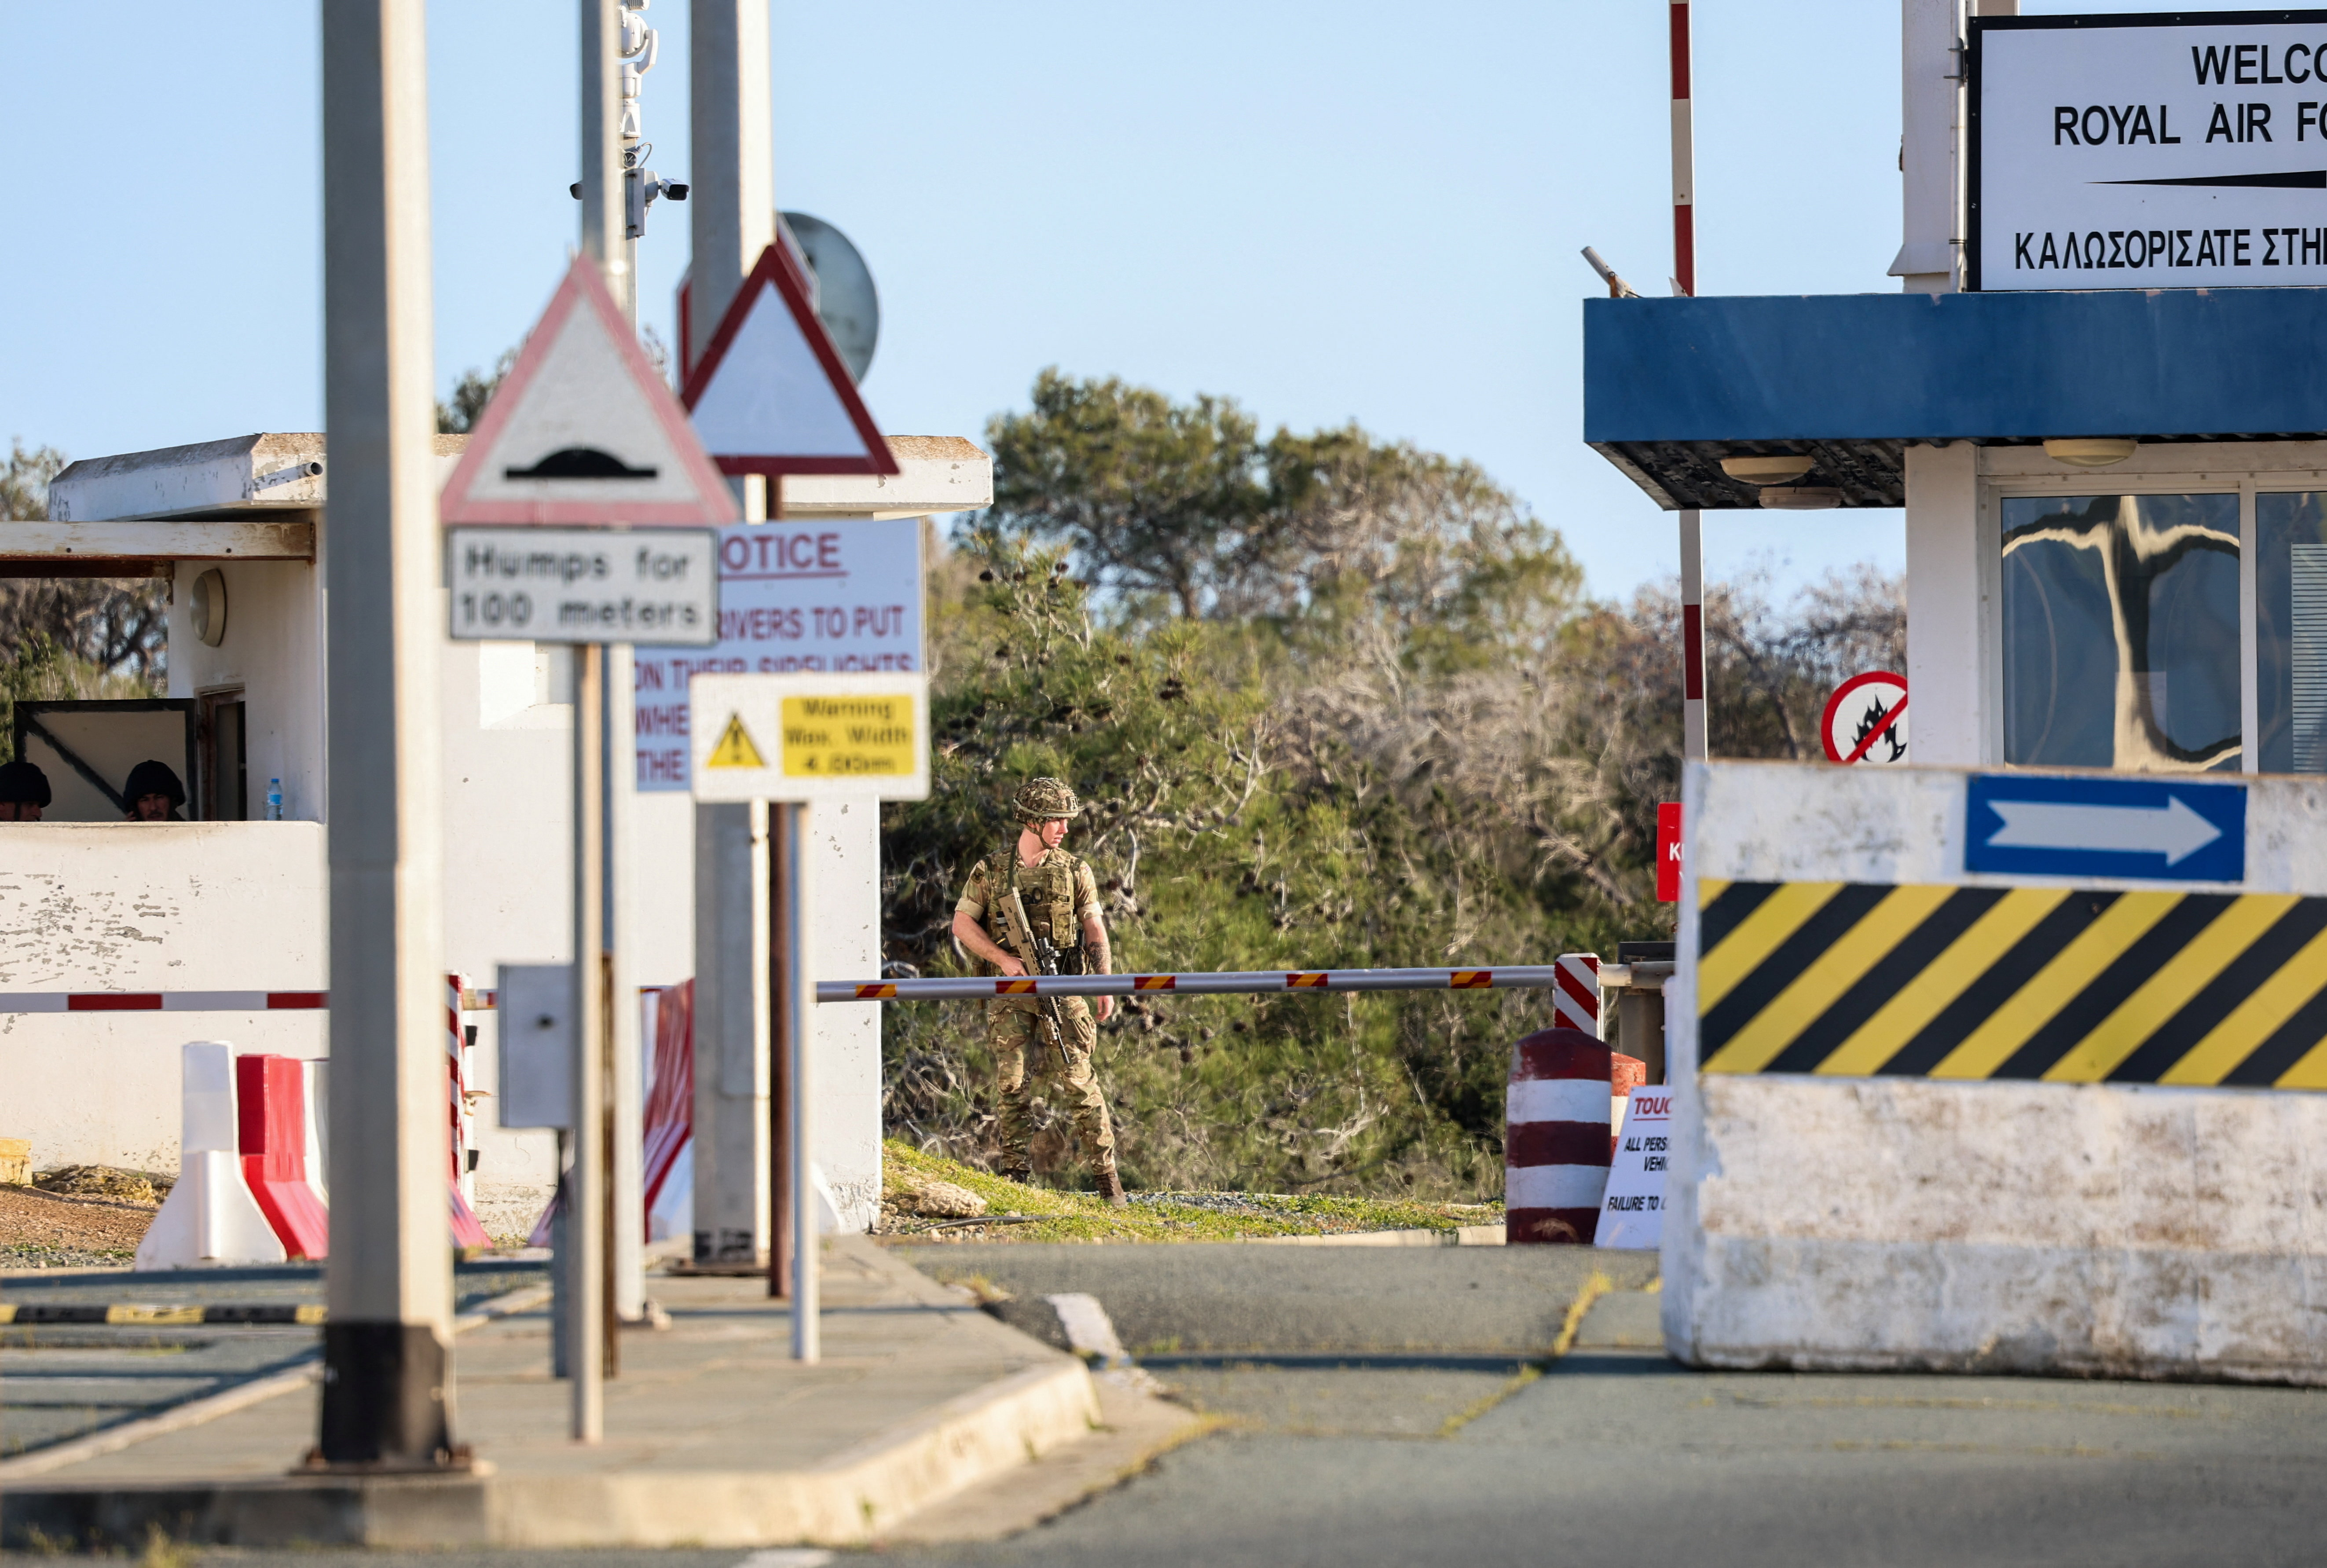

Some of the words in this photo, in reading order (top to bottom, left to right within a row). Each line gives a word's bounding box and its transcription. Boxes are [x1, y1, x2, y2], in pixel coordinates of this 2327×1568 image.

[2054, 105, 2180, 145] ROYAL
[2205, 103, 2272, 143] AIR
[2015, 229, 2250, 269] ΚΑΛΩΣΟΡΙΣΑΤΕ
[2262, 227, 2327, 265] ΣΤΗ
[466, 545, 609, 585] Humps
[635, 546, 689, 579] for
[720, 533, 842, 570] OTICE
[462, 591, 533, 627] 100
[558, 597, 700, 626] meters
[810, 606, 848, 638] TO
[853, 604, 905, 638] PUT
[636, 705, 689, 736] WHE
[802, 699, 894, 720] Warning
[637, 750, 685, 781] THE
[1635, 1097, 1673, 1115] TOUC
[1624, 1137, 1640, 1152] ALL
[1643, 1137, 1671, 1151] PERS
[1607, 1196, 1645, 1212] FAILURE
[1647, 1196, 1659, 1211] TO
